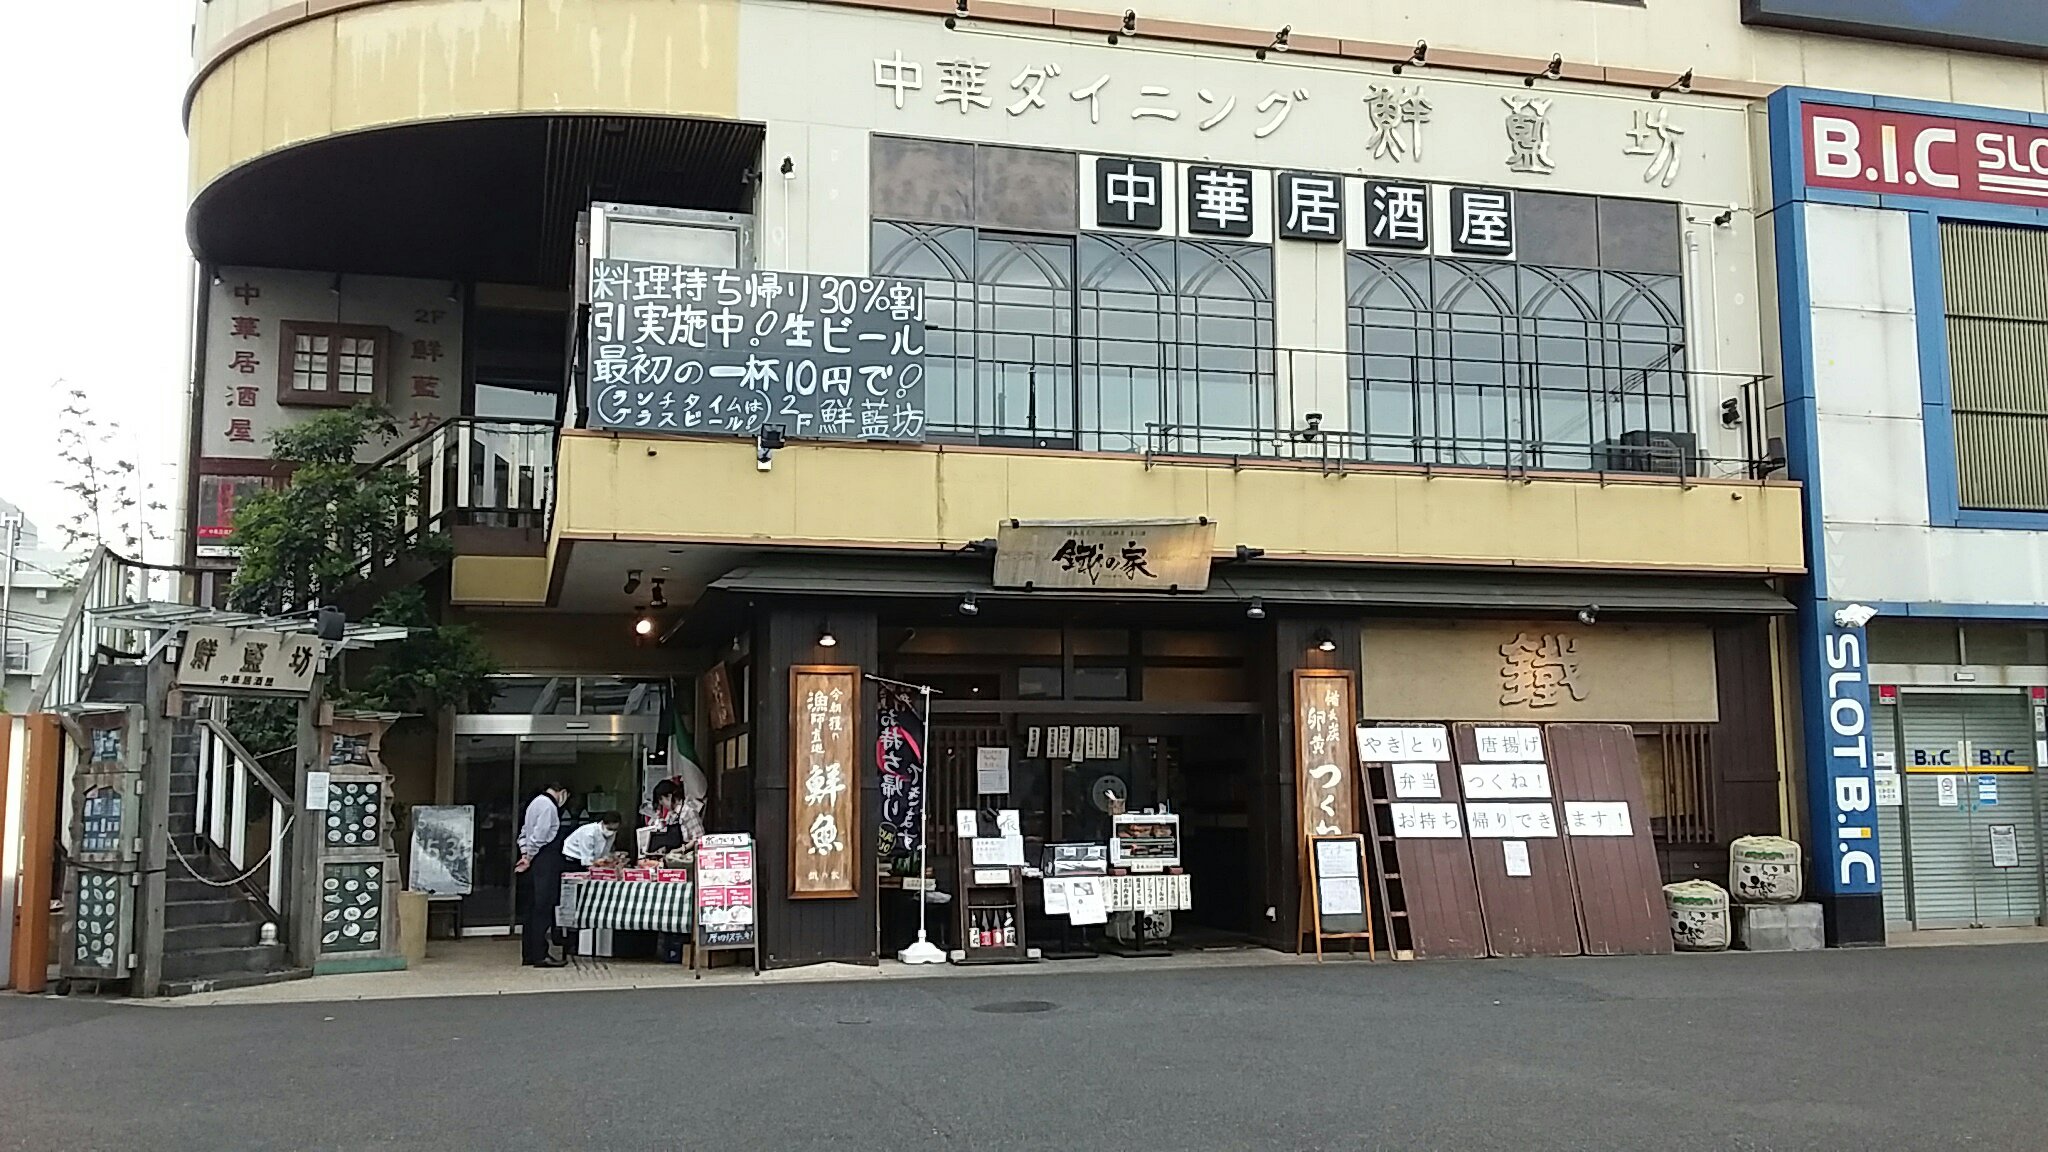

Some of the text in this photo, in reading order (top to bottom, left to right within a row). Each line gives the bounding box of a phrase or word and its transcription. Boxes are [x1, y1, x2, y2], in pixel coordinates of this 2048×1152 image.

[873, 49, 1310, 138] 中華ダイニング
[1812, 115, 1960, 189] B.I.C
[1106, 162, 1512, 248] 中華居酒屋
[414, 308, 446, 324] 2F
[224, 282, 261, 443] 中華居酒屋
[1307, 706, 1327, 755] 卵黄
[1364, 735, 1443, 754] やきとり
[1481, 735, 1539, 755] 唐揚げ
[1825, 633, 1876, 885] SLOT B.I.C
[804, 762, 847, 857] 鮮魚
[1399, 772, 1438, 790] 弁当
[1398, 811, 1458, 829] お持ち
